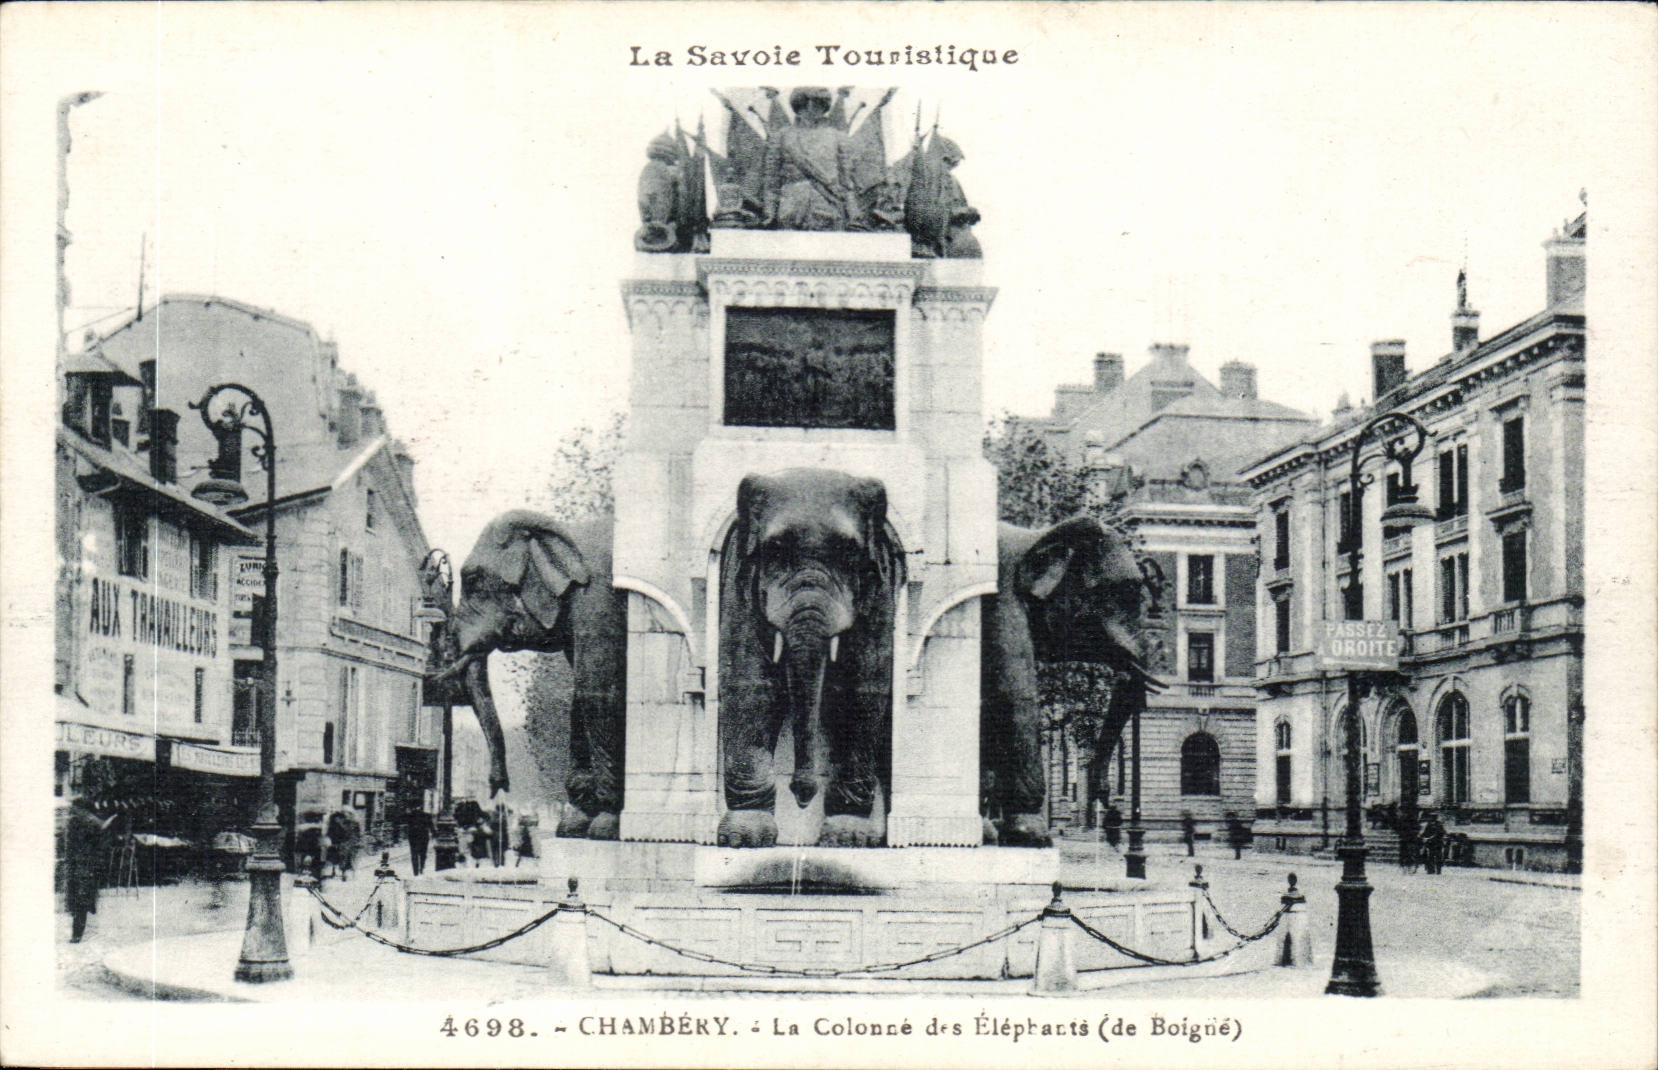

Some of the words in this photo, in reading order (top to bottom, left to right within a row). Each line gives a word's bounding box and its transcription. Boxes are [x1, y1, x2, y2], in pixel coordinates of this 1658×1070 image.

[90, 577, 120, 638] AUX
[131, 588, 217, 659] TRAVAILLEURS
[1327, 623, 1386, 638] PASSEZ
[1332, 640, 1397, 657] DROITE
